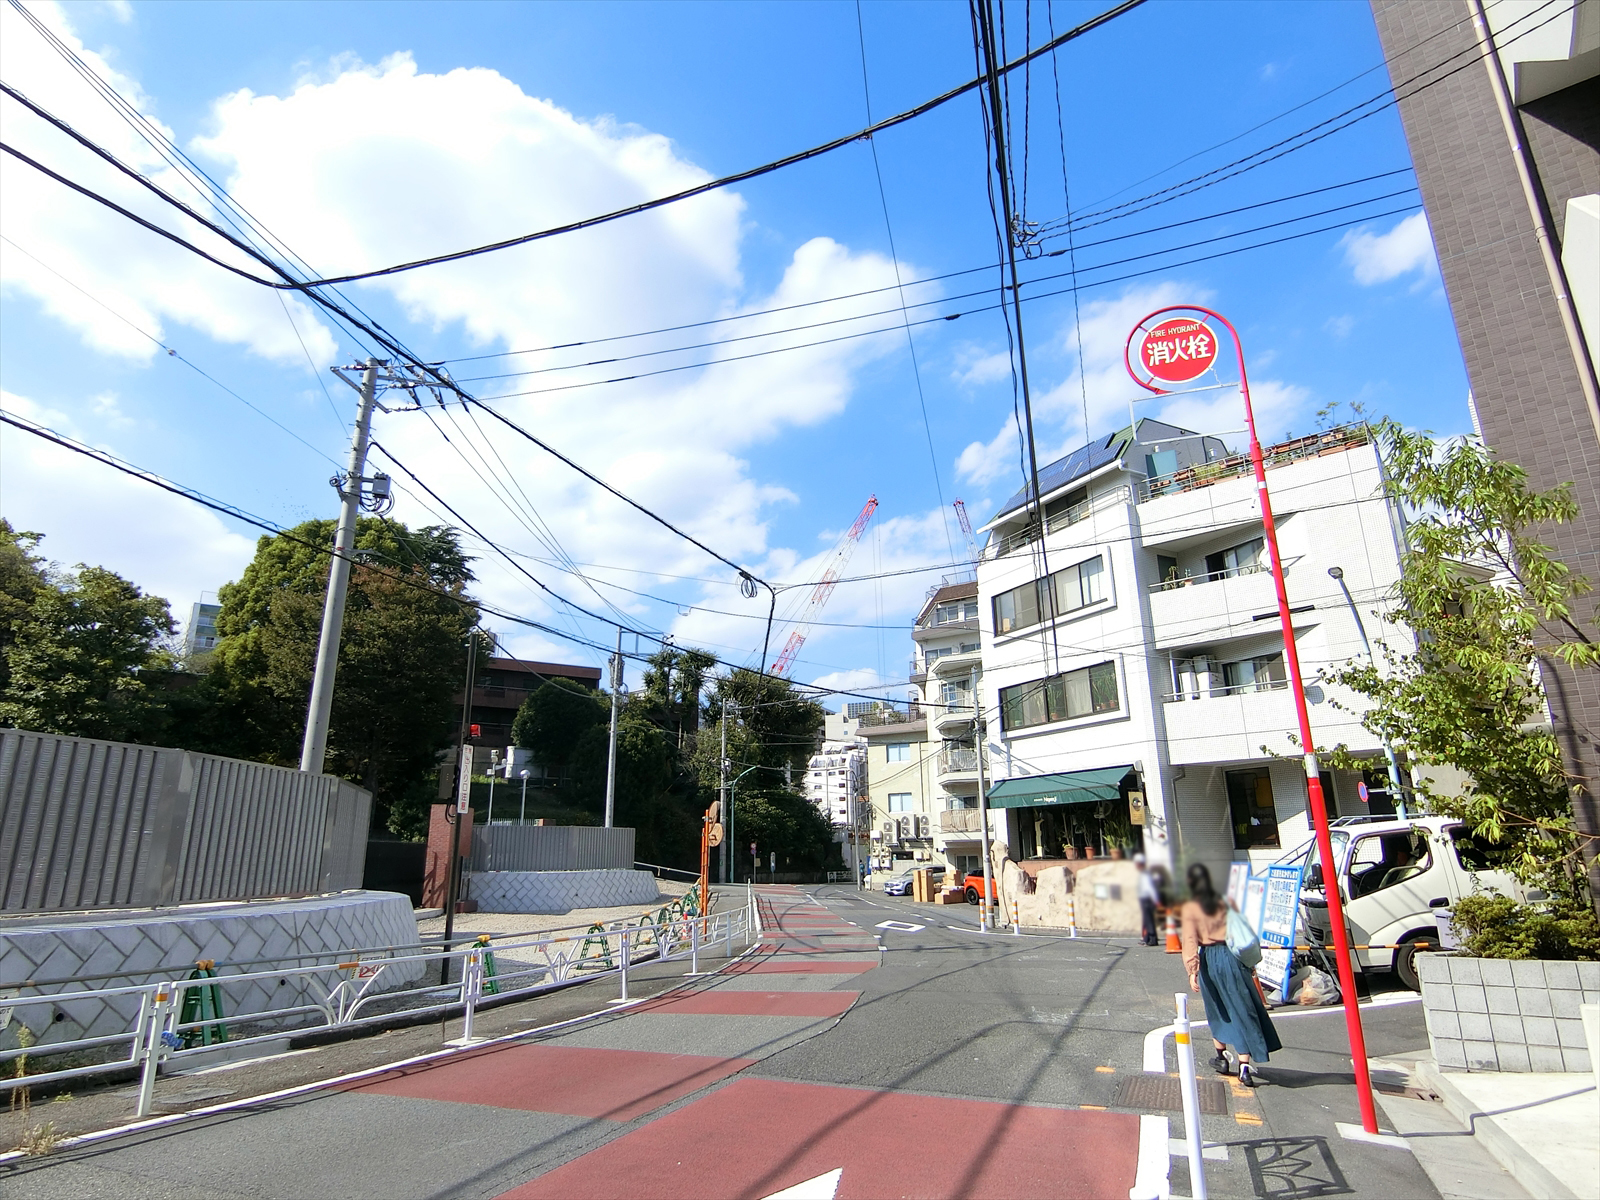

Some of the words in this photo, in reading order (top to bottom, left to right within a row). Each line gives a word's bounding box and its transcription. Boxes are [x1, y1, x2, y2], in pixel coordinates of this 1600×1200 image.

[1150, 329, 1166, 338] FIRE
[1168, 323, 1200, 336] HYDRANT
[1146, 334, 1211, 366] 消火栓
